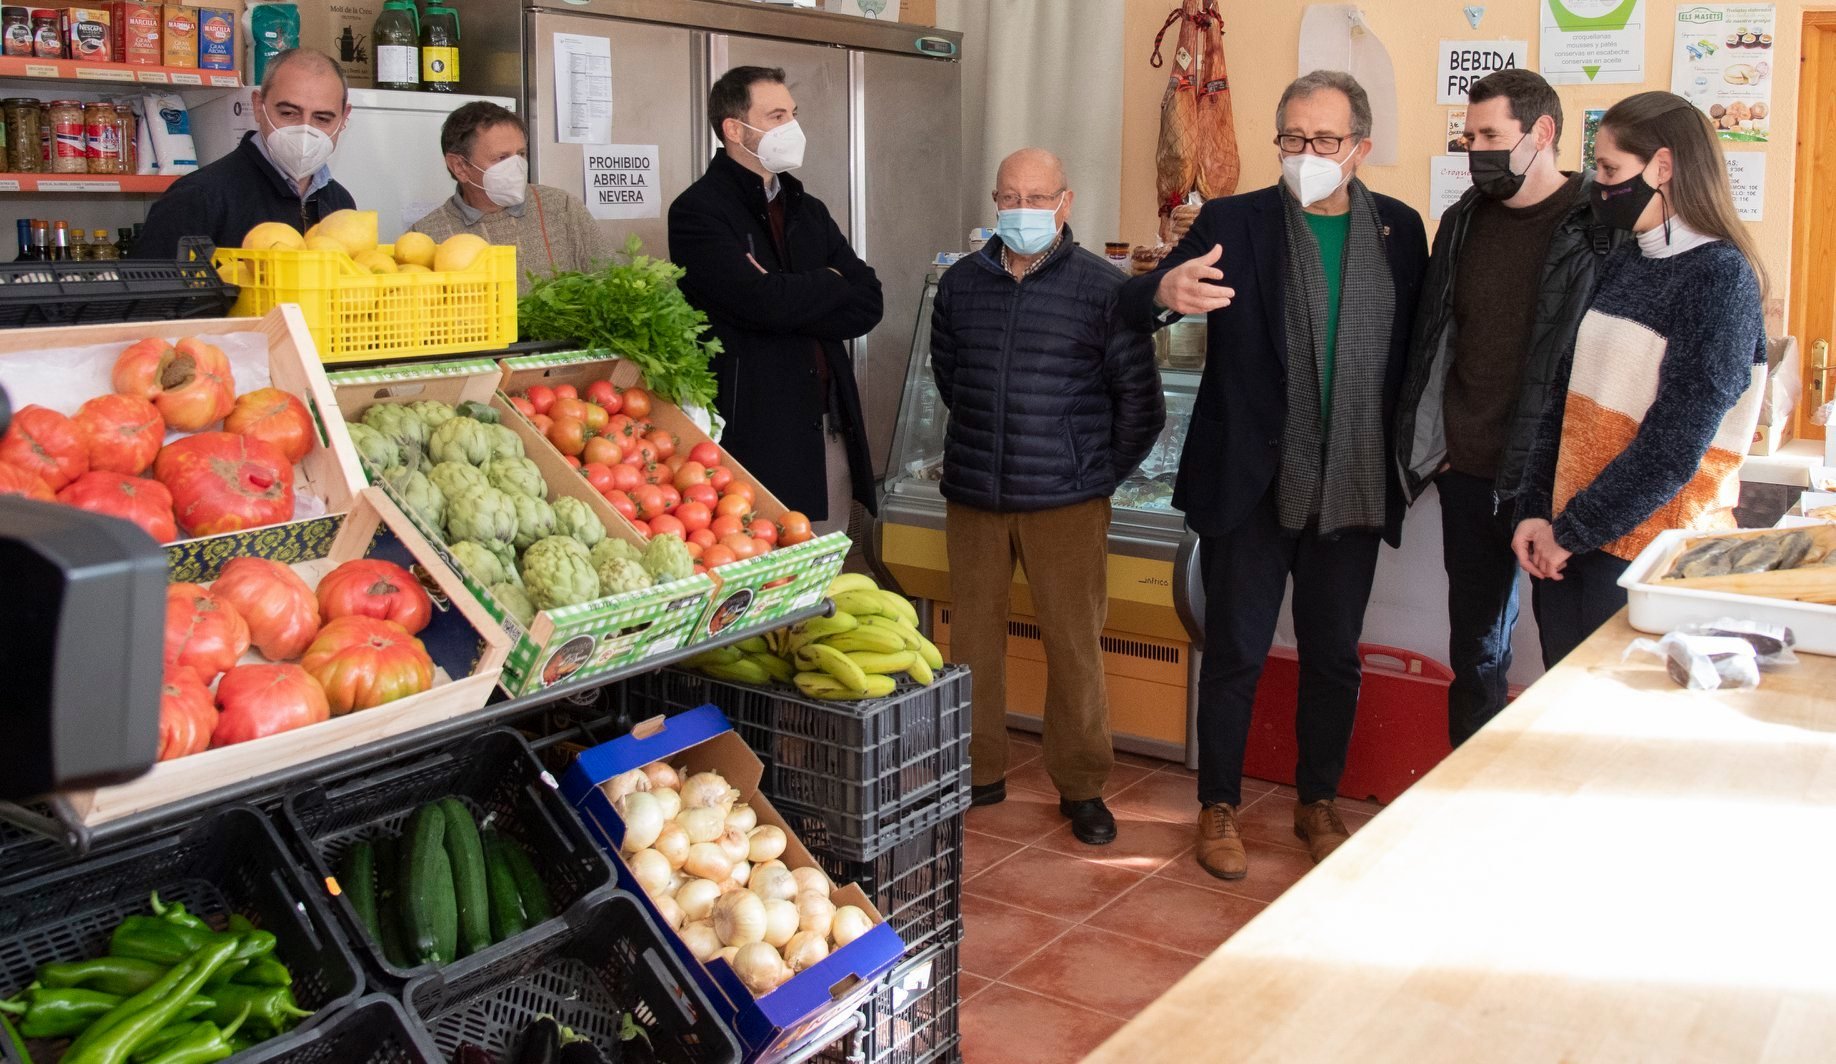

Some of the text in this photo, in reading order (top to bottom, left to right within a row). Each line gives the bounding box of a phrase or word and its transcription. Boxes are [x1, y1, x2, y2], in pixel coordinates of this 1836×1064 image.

[1450, 50, 1515, 70] BEBIDA
[589, 156, 650, 168] PROHIBIDO
[594, 174, 644, 185] ABRIR LA
[599, 190, 644, 202] NEVERA
